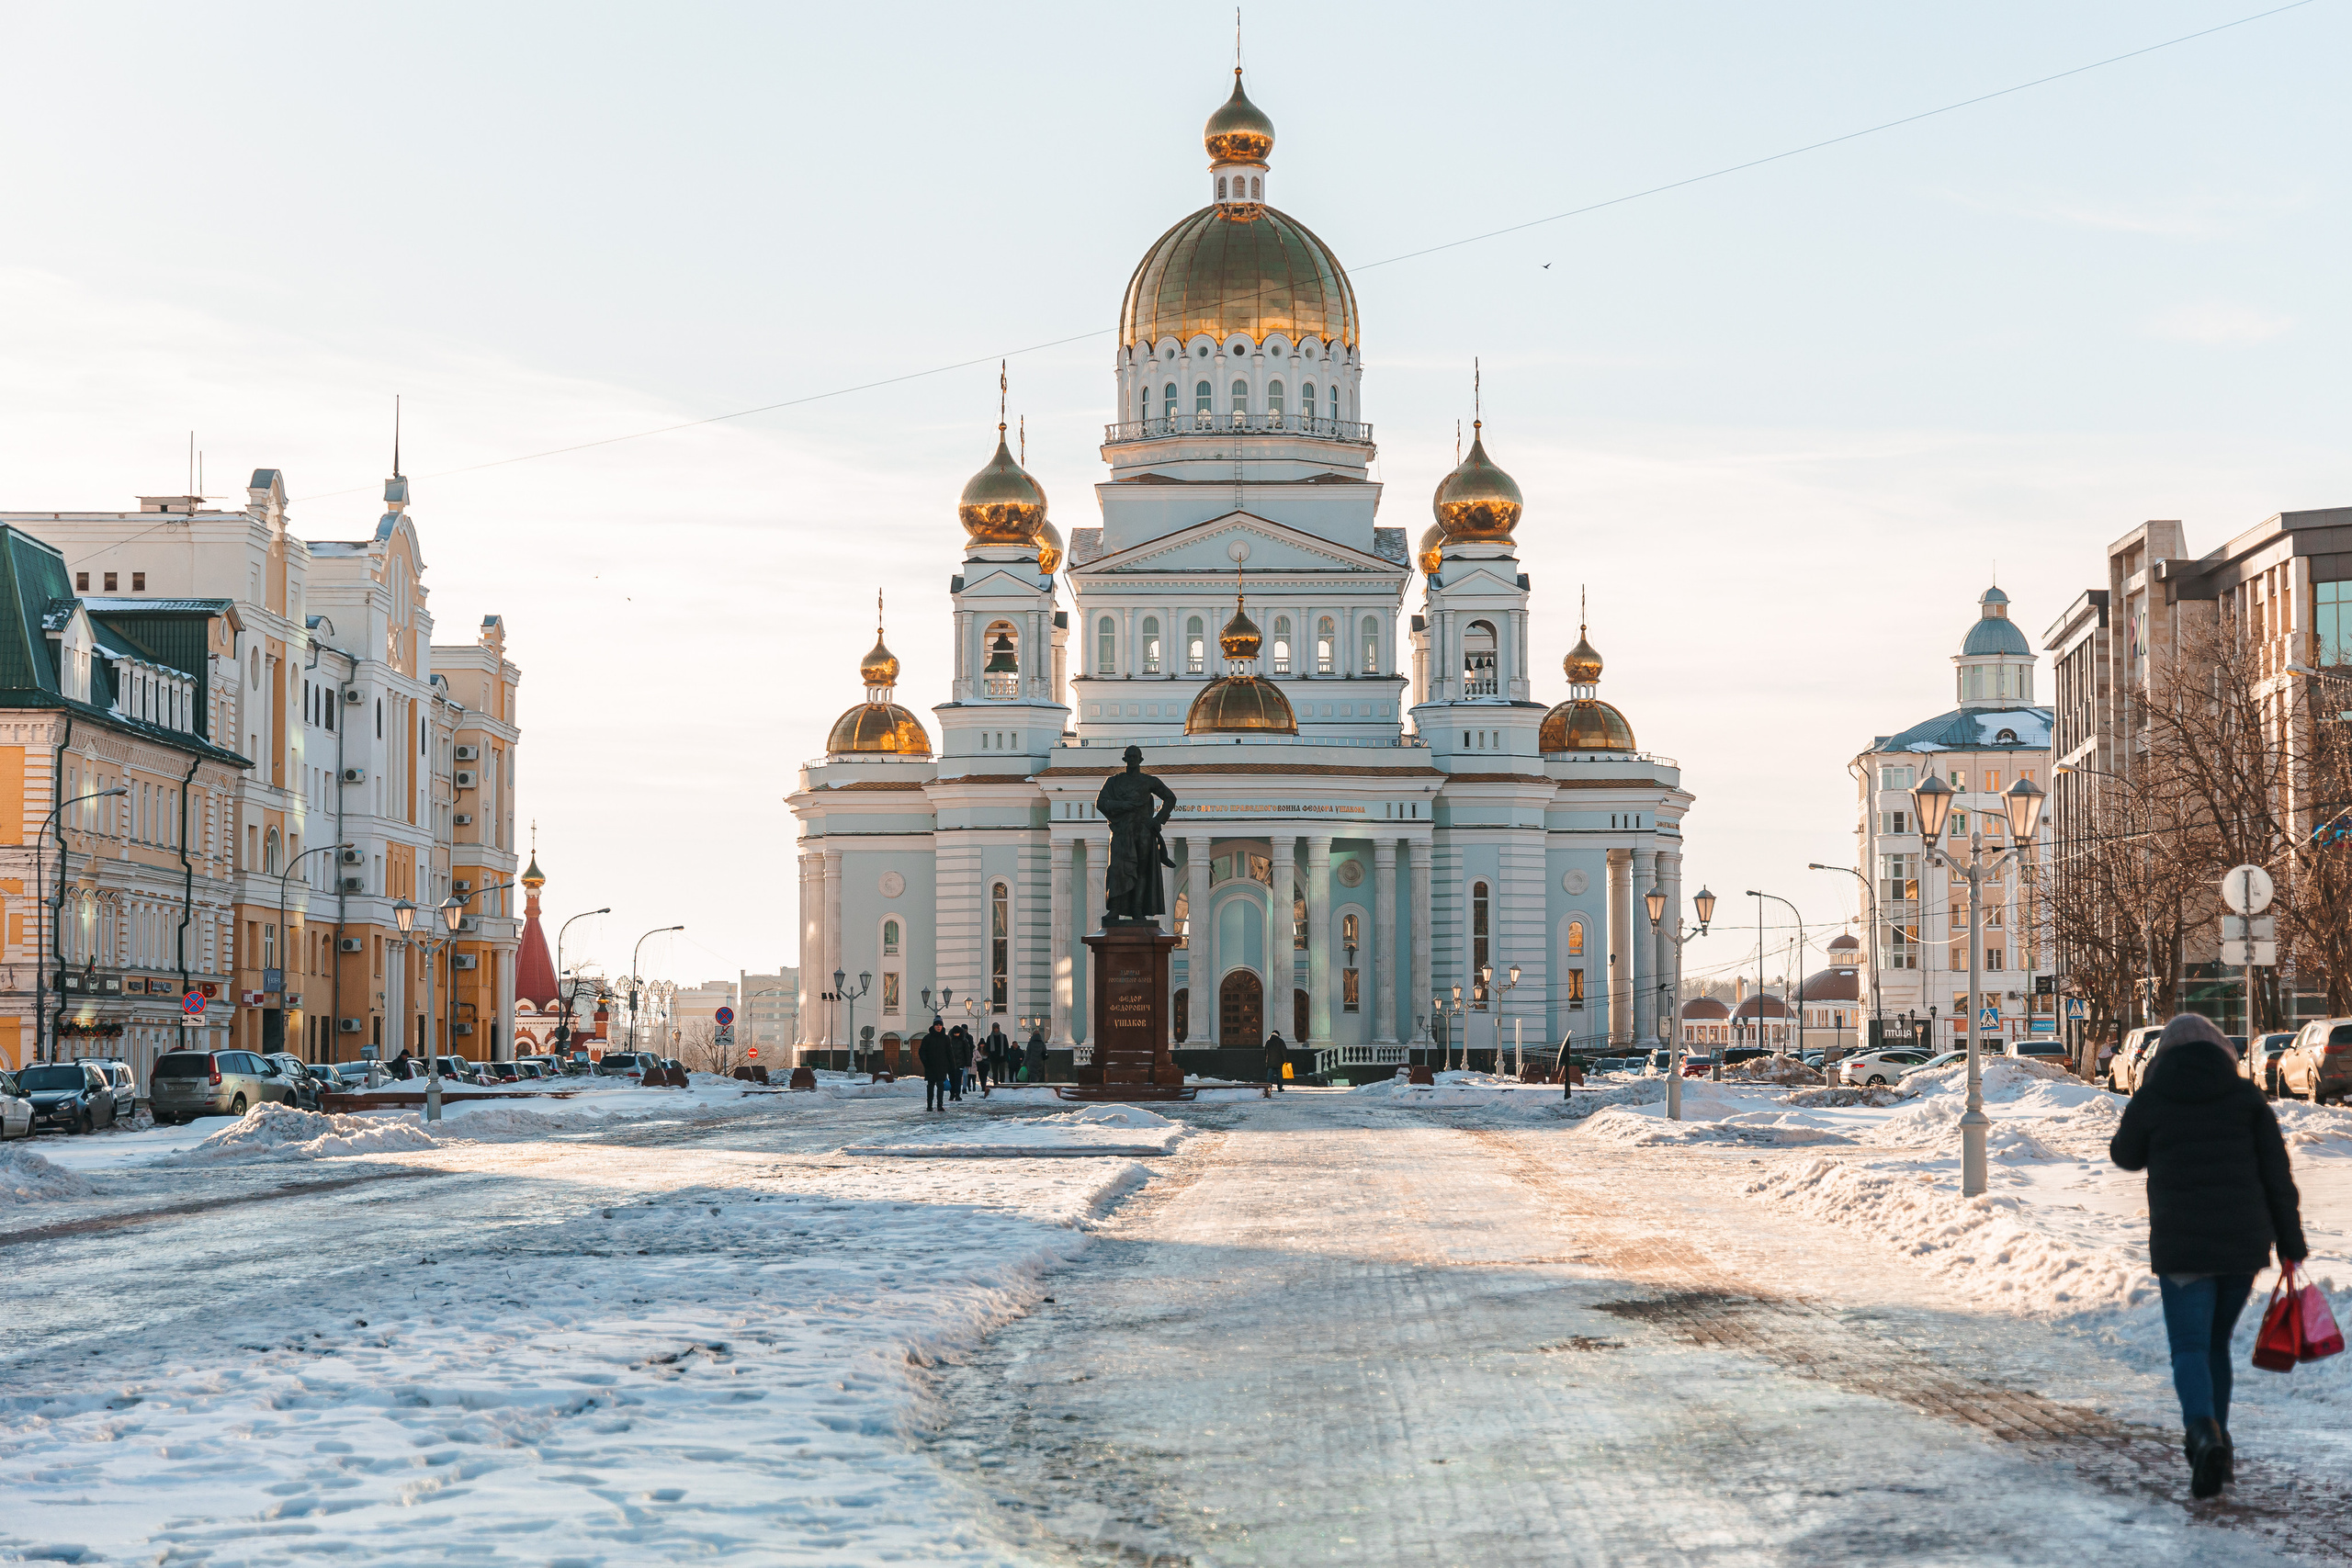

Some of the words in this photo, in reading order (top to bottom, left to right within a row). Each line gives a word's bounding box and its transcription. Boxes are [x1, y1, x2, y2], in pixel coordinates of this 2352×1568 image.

[2131, 613, 2147, 659] РИ
[1230, 805, 1277, 813] ПРАВЕДНОГО
[1335, 806, 1365, 814] УШАКОВА
[1118, 995, 1142, 1003] ФЕДОР
[1114, 1019, 1147, 1029] УШАКОВ
[1884, 1029, 1912, 1038] ПТИЦА
